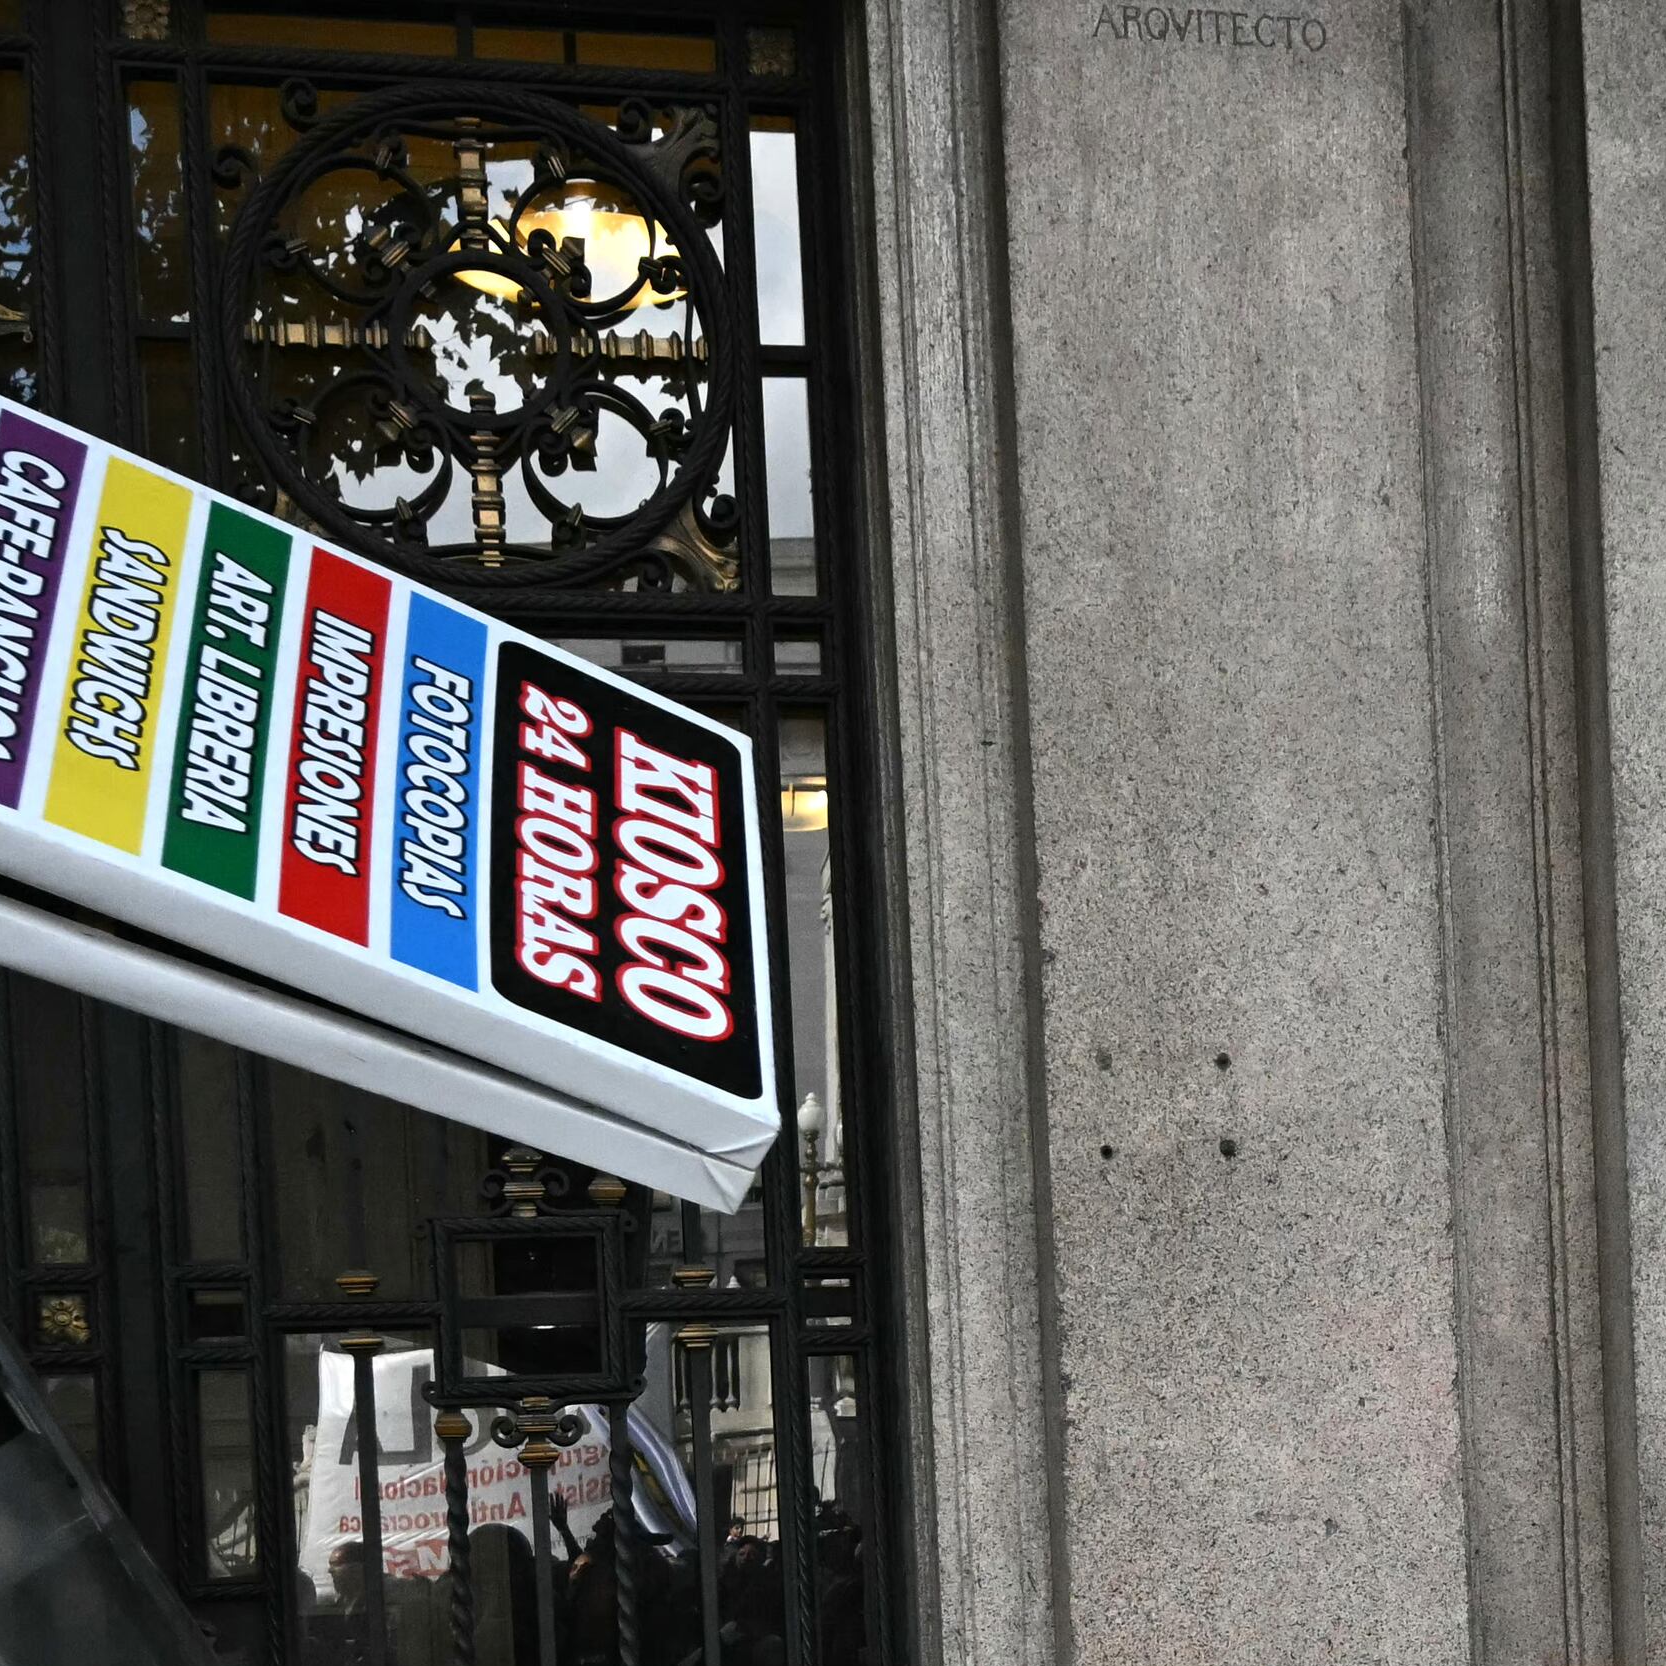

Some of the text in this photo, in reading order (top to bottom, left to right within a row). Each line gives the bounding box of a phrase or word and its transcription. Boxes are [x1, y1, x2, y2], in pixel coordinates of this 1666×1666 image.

[65, 526, 174, 773] SANDWICHS
[181, 551, 276, 834] ART. LIBRERIA
[292, 607, 374, 877] IMPRESIONES
[398, 654, 473, 920] FOTOCOPIAS
[514, 679, 602, 1002] 24 HORAS
[610, 726, 732, 1042] KIOSCO
